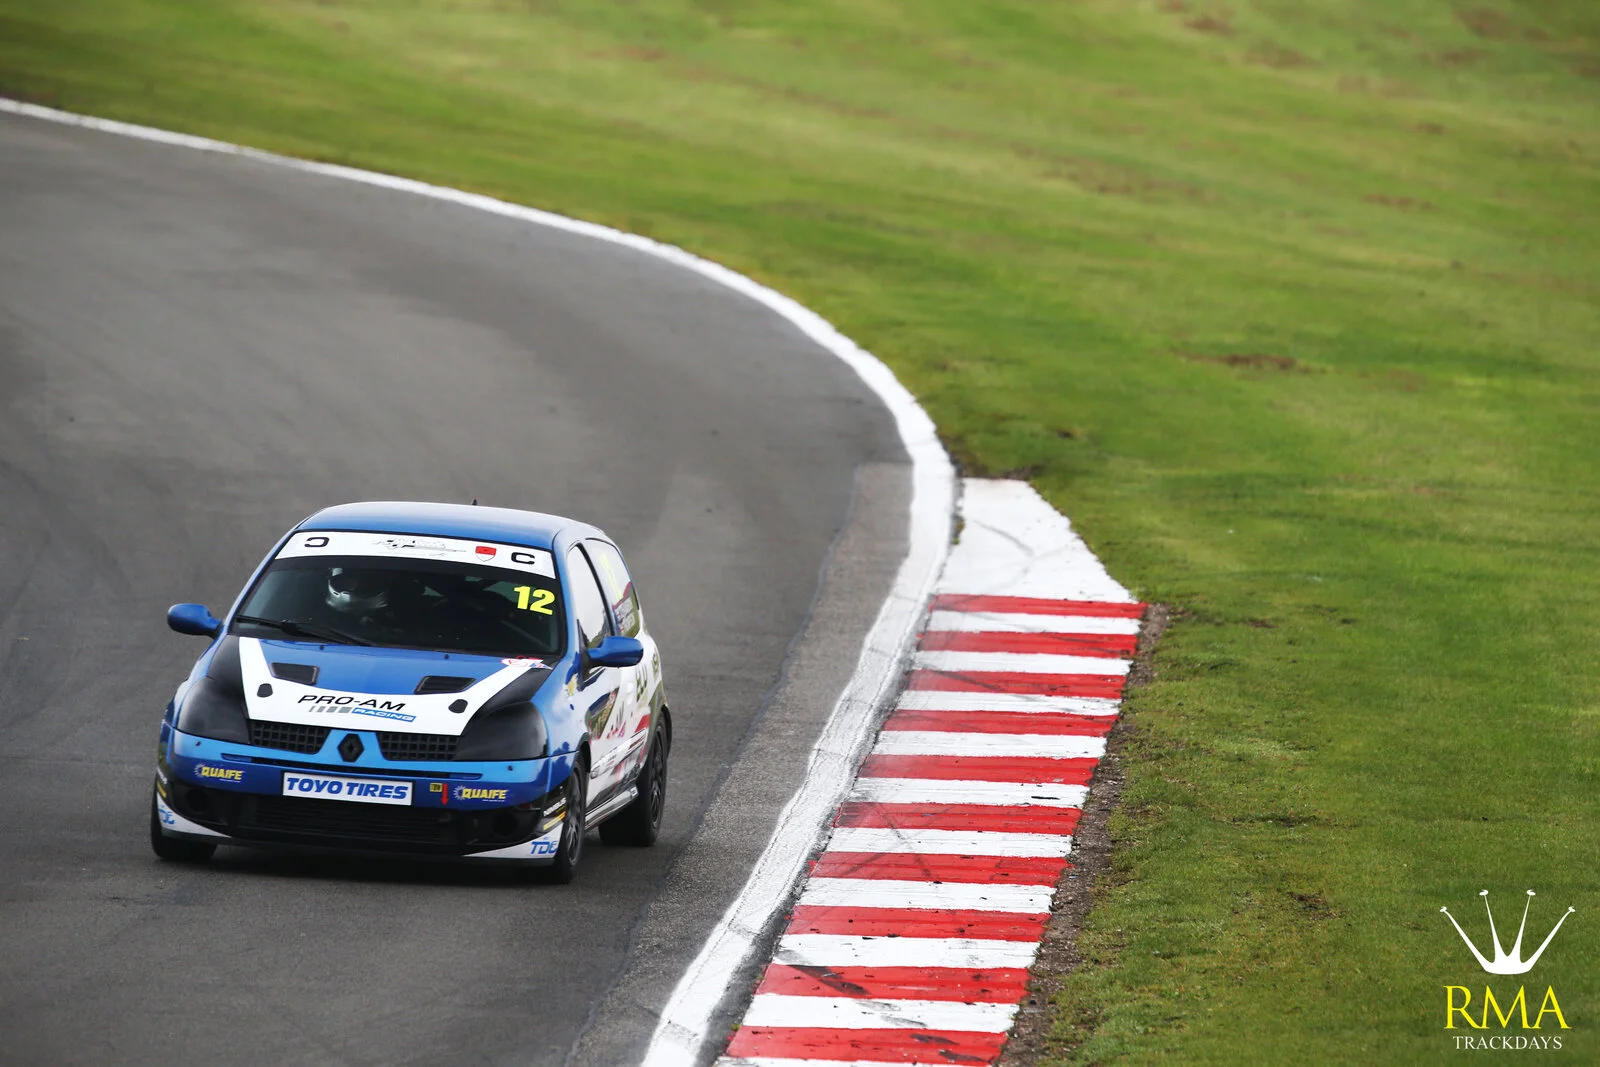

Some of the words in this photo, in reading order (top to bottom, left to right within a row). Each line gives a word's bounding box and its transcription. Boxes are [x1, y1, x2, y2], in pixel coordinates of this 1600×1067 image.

[513, 585, 556, 616] 12
[297, 694, 406, 711] PRO-AM
[353, 708, 414, 721] RACING
[201, 766, 246, 781] QUAIFE
[287, 777, 343, 795] TOYO
[346, 782, 409, 800] TIRES
[462, 788, 509, 799] QUAIFE
